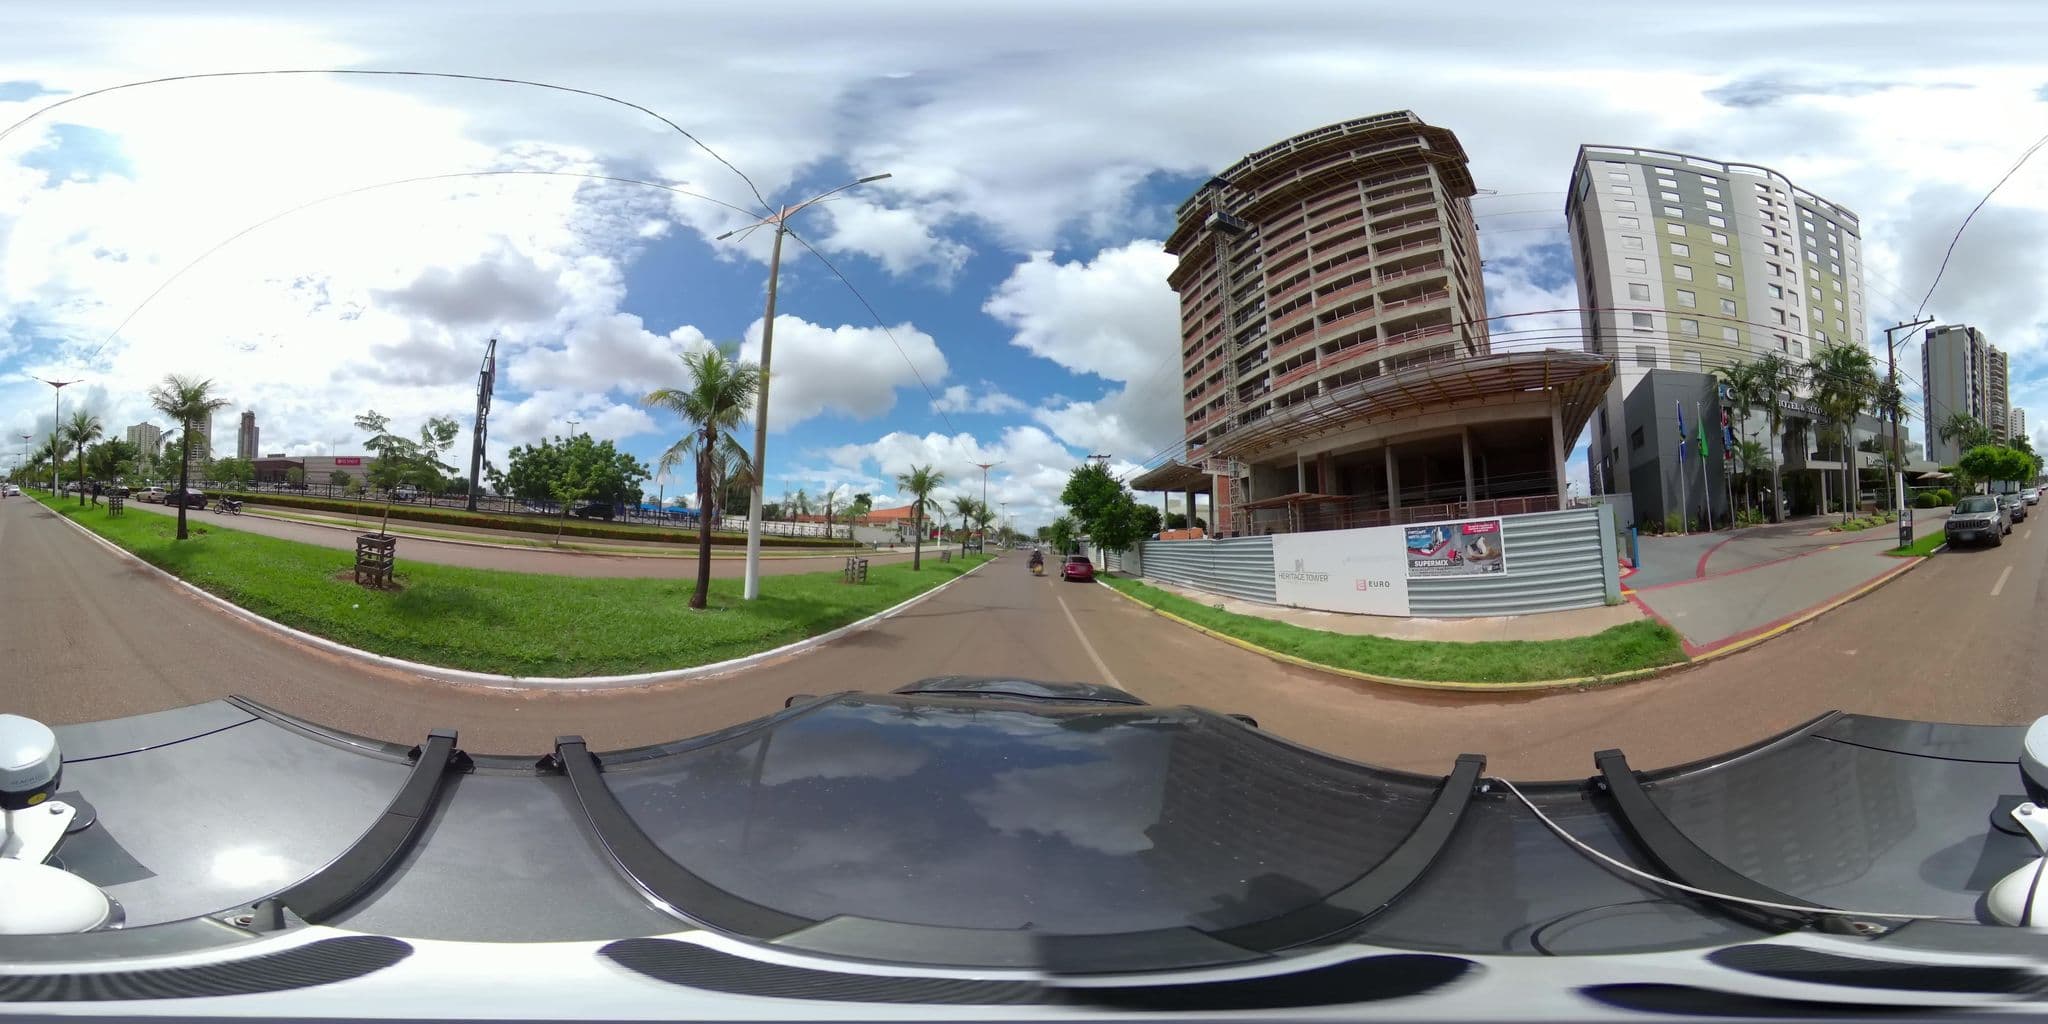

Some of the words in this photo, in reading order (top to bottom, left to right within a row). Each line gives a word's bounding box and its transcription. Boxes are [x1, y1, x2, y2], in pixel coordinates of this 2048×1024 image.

[1414, 559, 1449, 567] SUPERMIX
[1278, 572, 1305, 581] HERITAGE
[1305, 574, 1329, 583] TOWER
[1368, 580, 1390, 588] EURO
